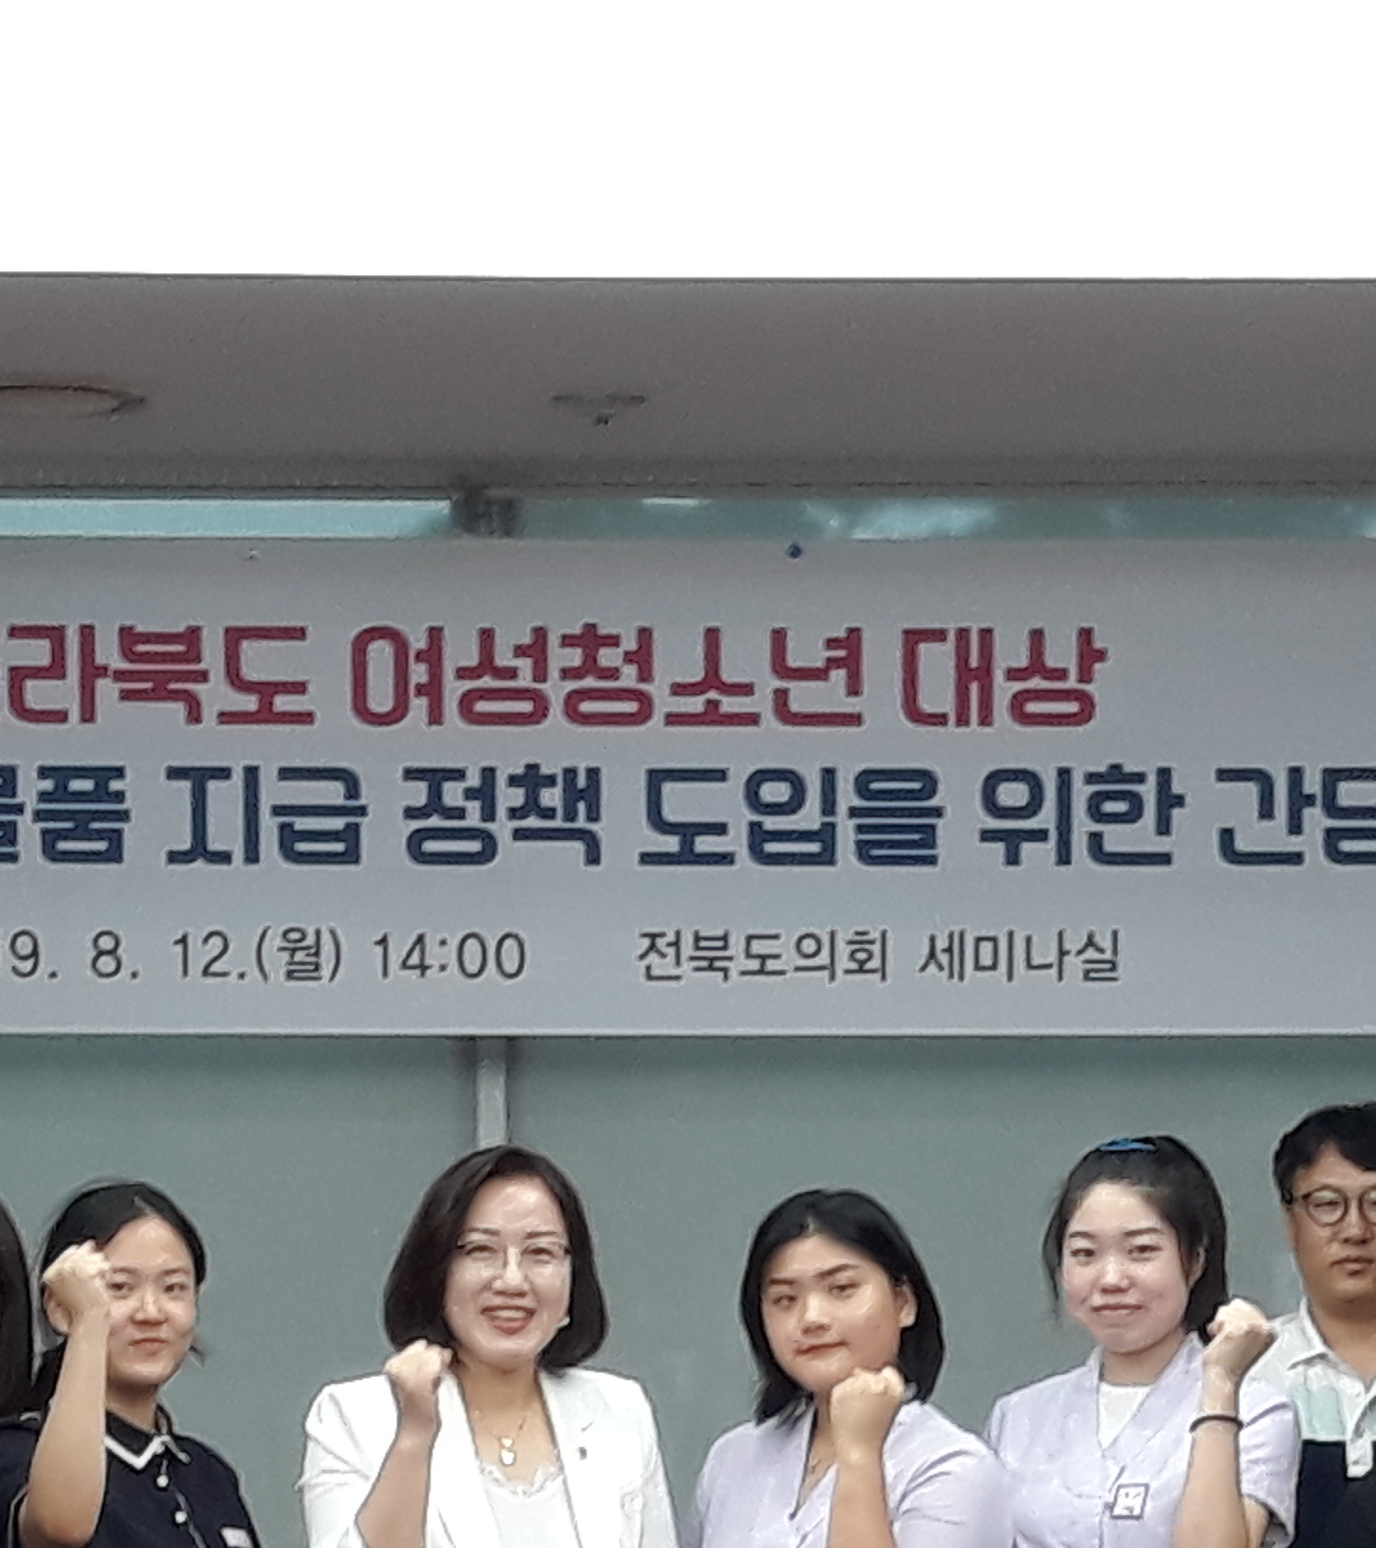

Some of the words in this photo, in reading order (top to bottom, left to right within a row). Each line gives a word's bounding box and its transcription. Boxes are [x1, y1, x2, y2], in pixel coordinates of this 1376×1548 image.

[351, 622, 864, 727] 여성청소년
[901, 627, 1108, 728] 대상
[165, 765, 369, 866] 지급
[402, 762, 602, 867] 정책
[638, 766, 946, 867] 도입을
[979, 763, 1187, 867] 위한
[91, 930, 139, 979] 8.
[374, 932, 526, 979] 14:00
[638, 929, 888, 984] 전북도의회
[918, 928, 1119, 983] 세미나실
